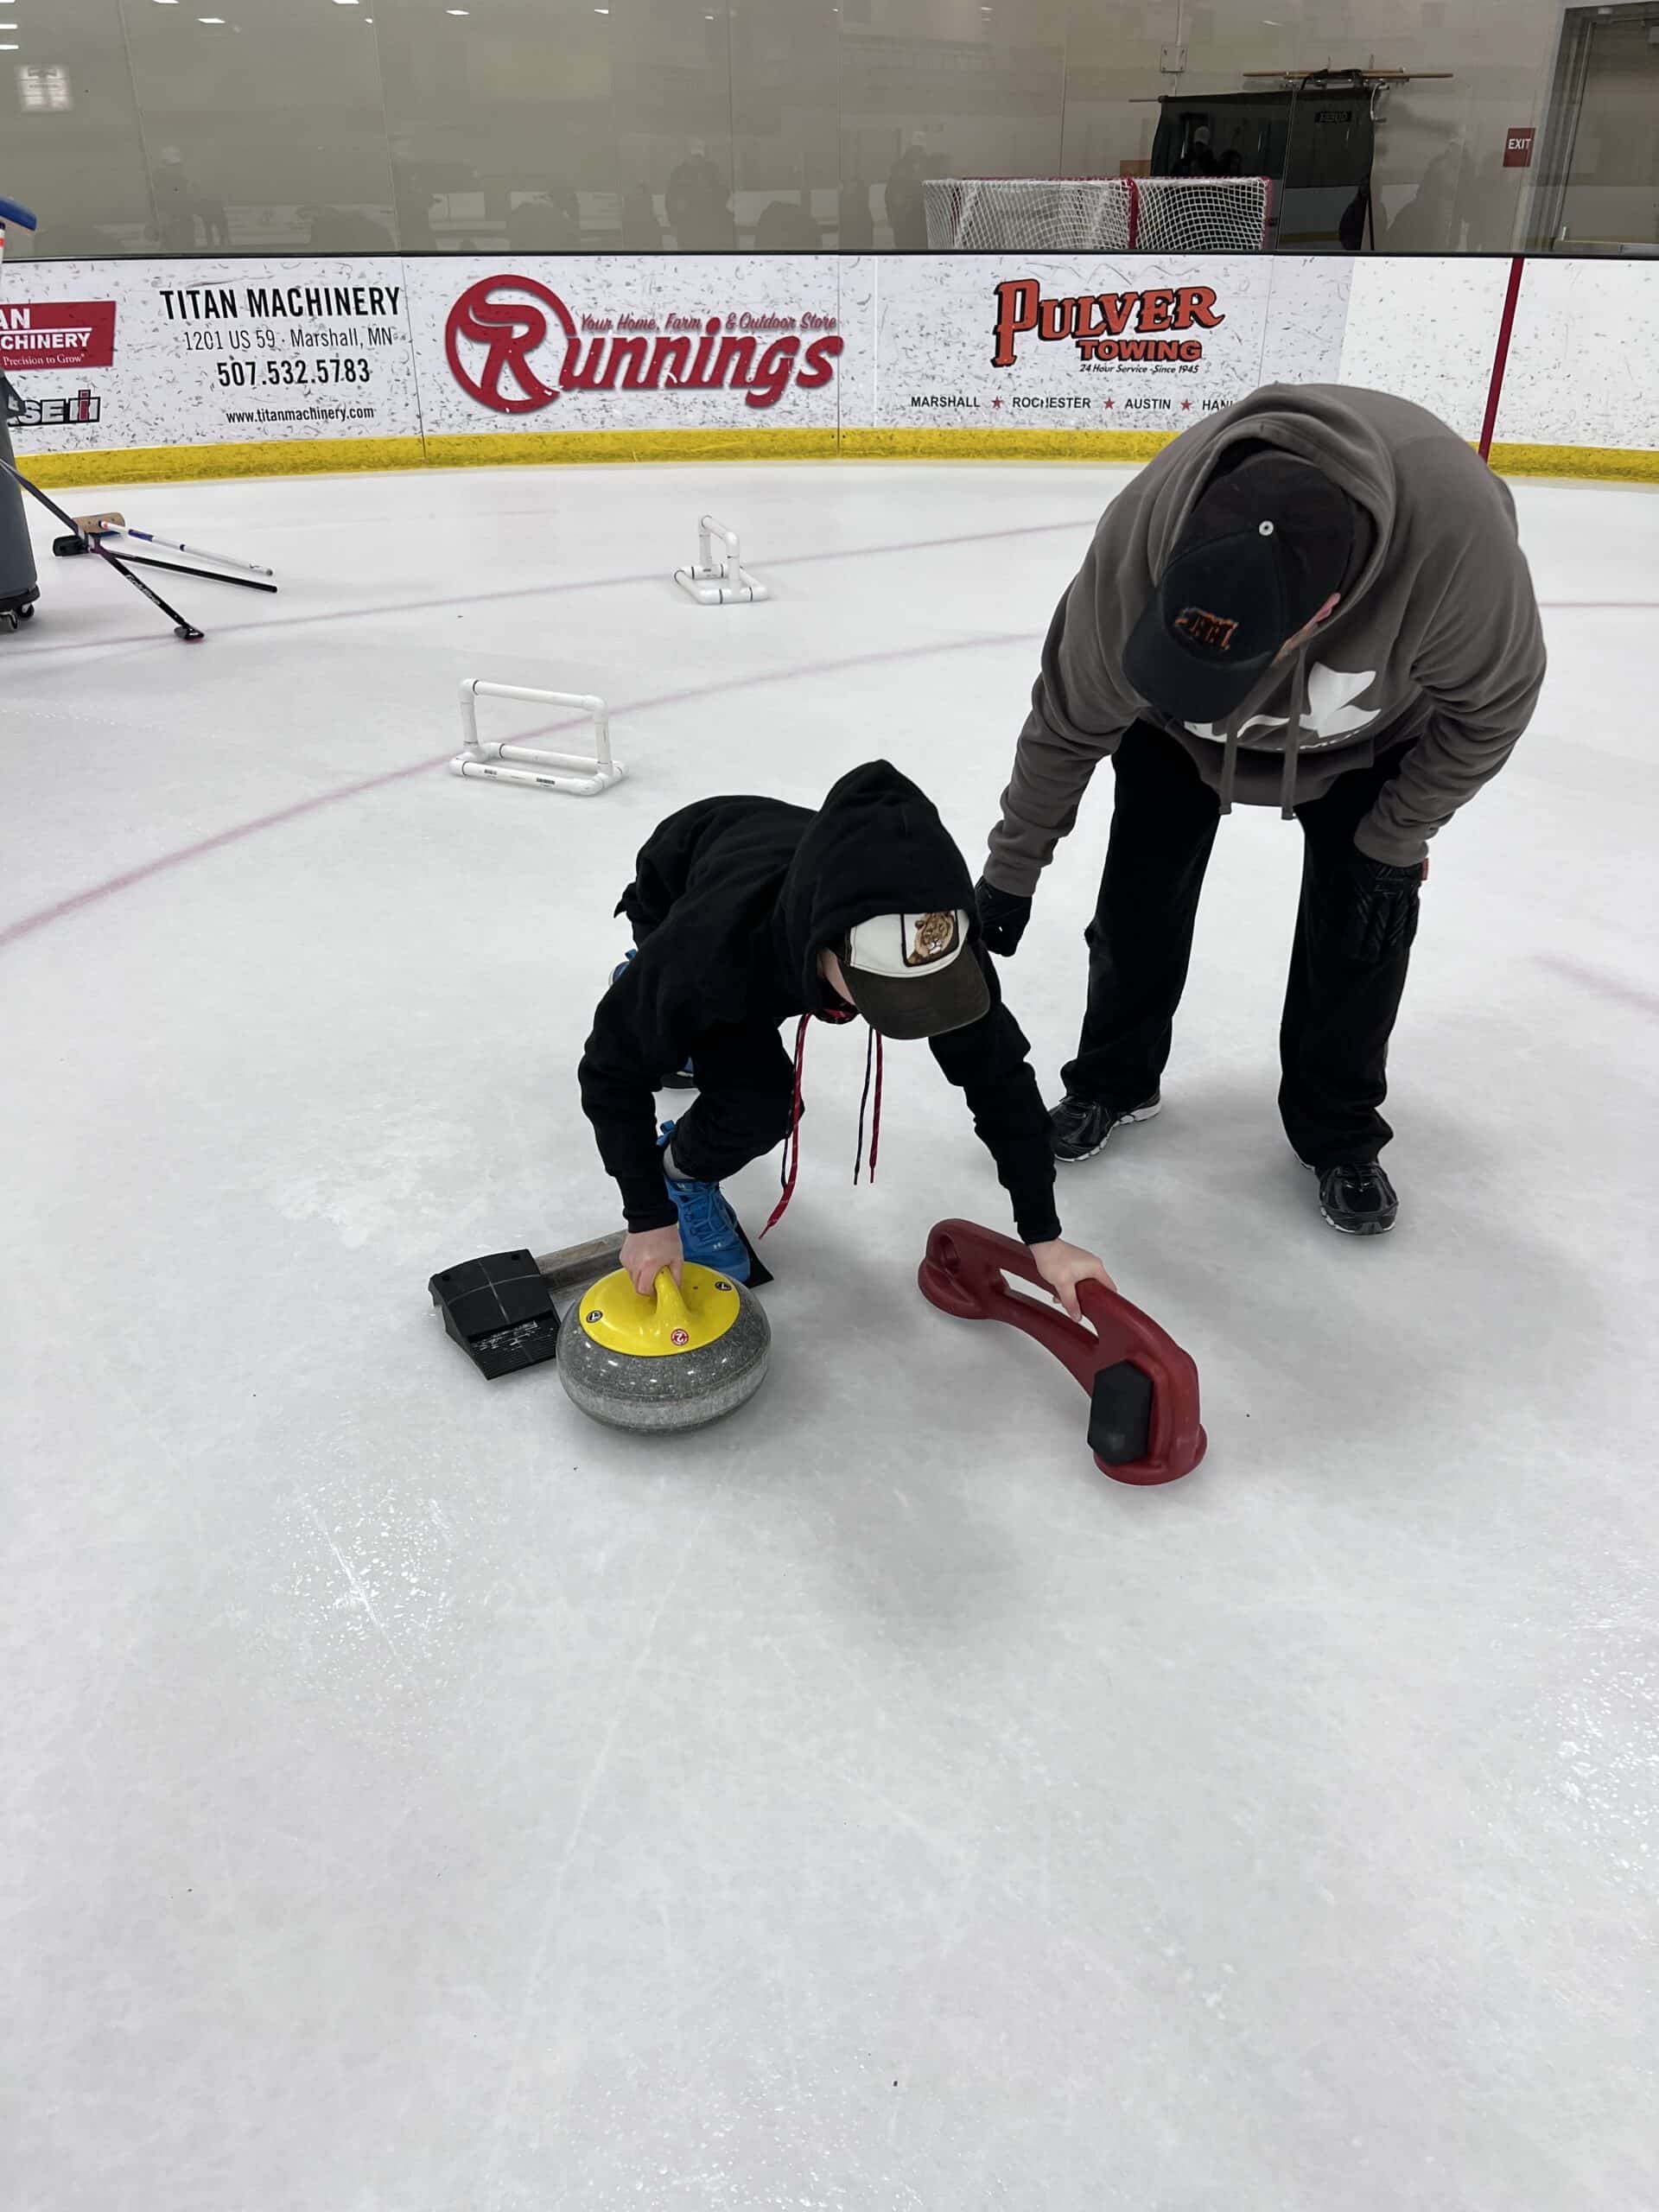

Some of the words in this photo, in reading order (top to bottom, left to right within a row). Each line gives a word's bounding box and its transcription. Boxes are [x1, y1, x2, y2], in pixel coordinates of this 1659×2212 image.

[1508, 138, 1532, 149] EXIT
[159, 289, 238, 320] TITAN
[246, 286, 400, 318] MACHINERY
[581, 314, 613, 330] Your
[665, 313, 702, 329] Farm
[726, 313, 736, 329] &
[739, 312, 798, 329] Outdoor
[800, 312, 836, 329] Store
[184, 331, 224, 351] 1201
[229, 330, 251, 349] US
[256, 329, 276, 348] 59
[290, 327, 365, 349] Marshall,
[368, 327, 393, 346] MN
[3, 354, 44, 366] Precision
[1076, 340, 1203, 362] TOWING
[217, 358, 371, 386] 507.532.5783
[1080, 364, 1091, 372] 24
[1093, 364, 1115, 372] Hour
[1116, 364, 1147, 372] Service
[1178, 365, 1199, 373] 1945
[911, 396, 981, 408] MARSHALL
[1012, 397, 1091, 410] ROCHESTER
[1124, 397, 1172, 410] AUSTIN
[226, 405, 374, 423] www.titanmachinery.com
